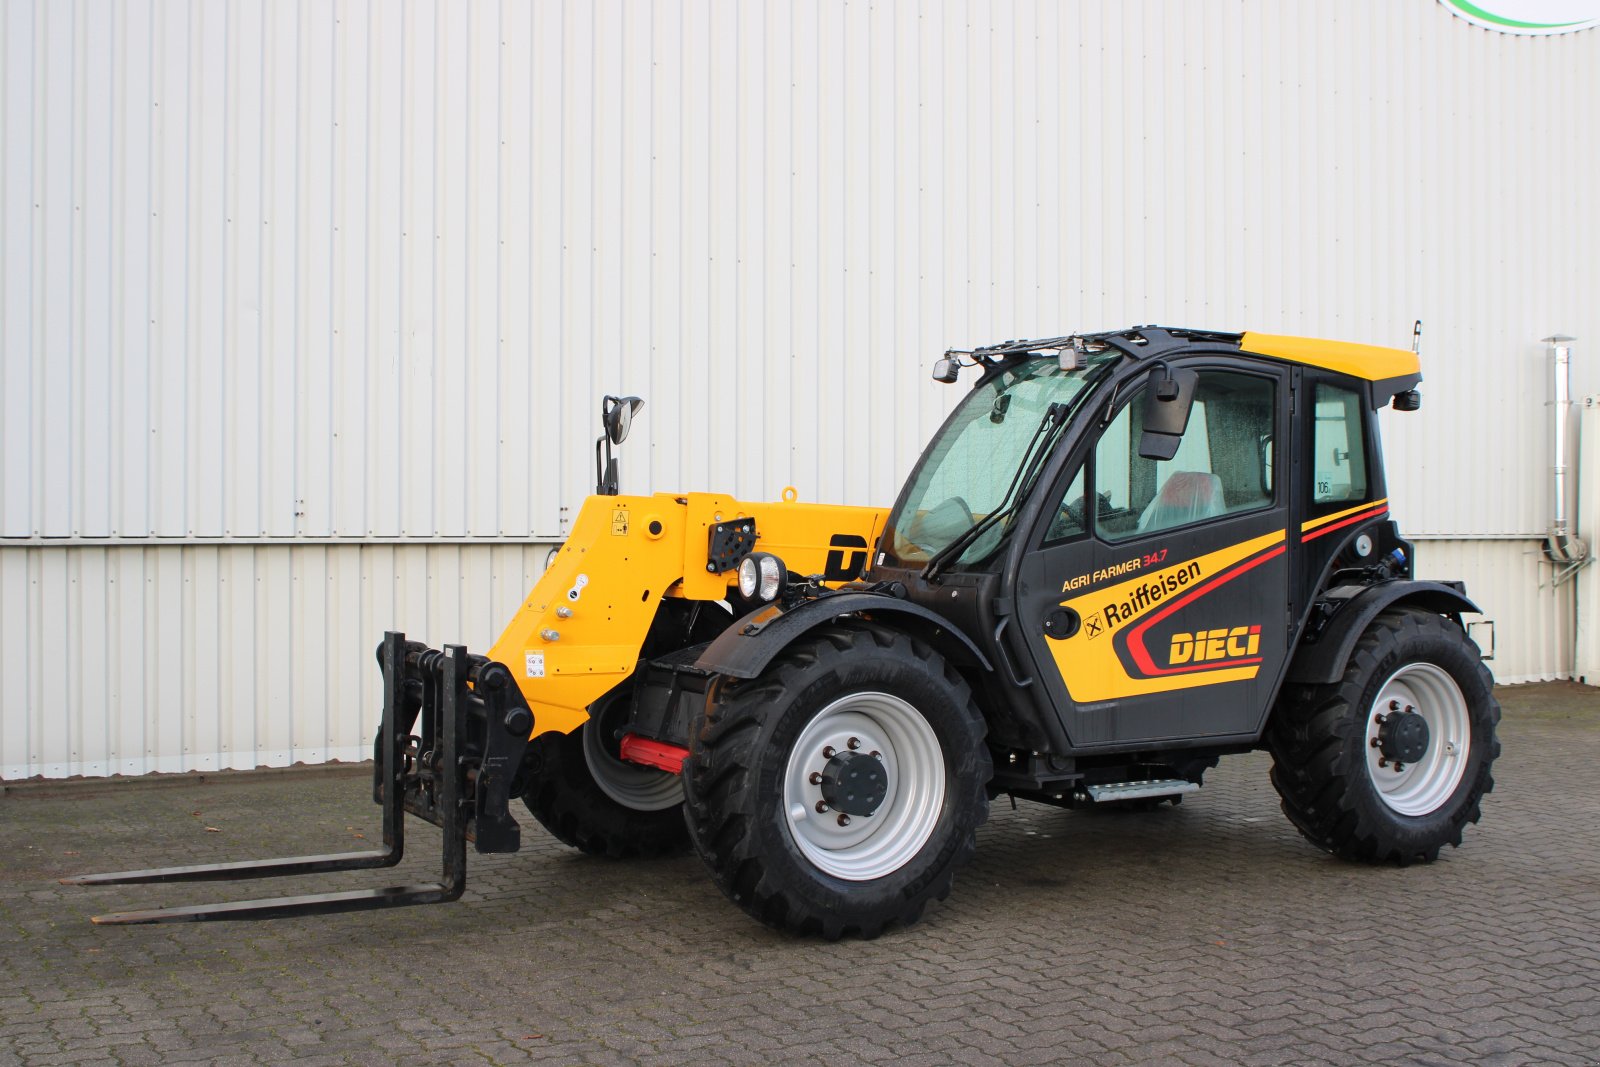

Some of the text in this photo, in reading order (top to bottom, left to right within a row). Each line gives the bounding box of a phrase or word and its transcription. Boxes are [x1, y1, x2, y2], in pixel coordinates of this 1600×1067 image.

[1318, 481, 1328, 493] 106
[1062, 549, 1168, 592] AGRI FARMER 34.7
[1103, 561, 1201, 628] Raiffeisen
